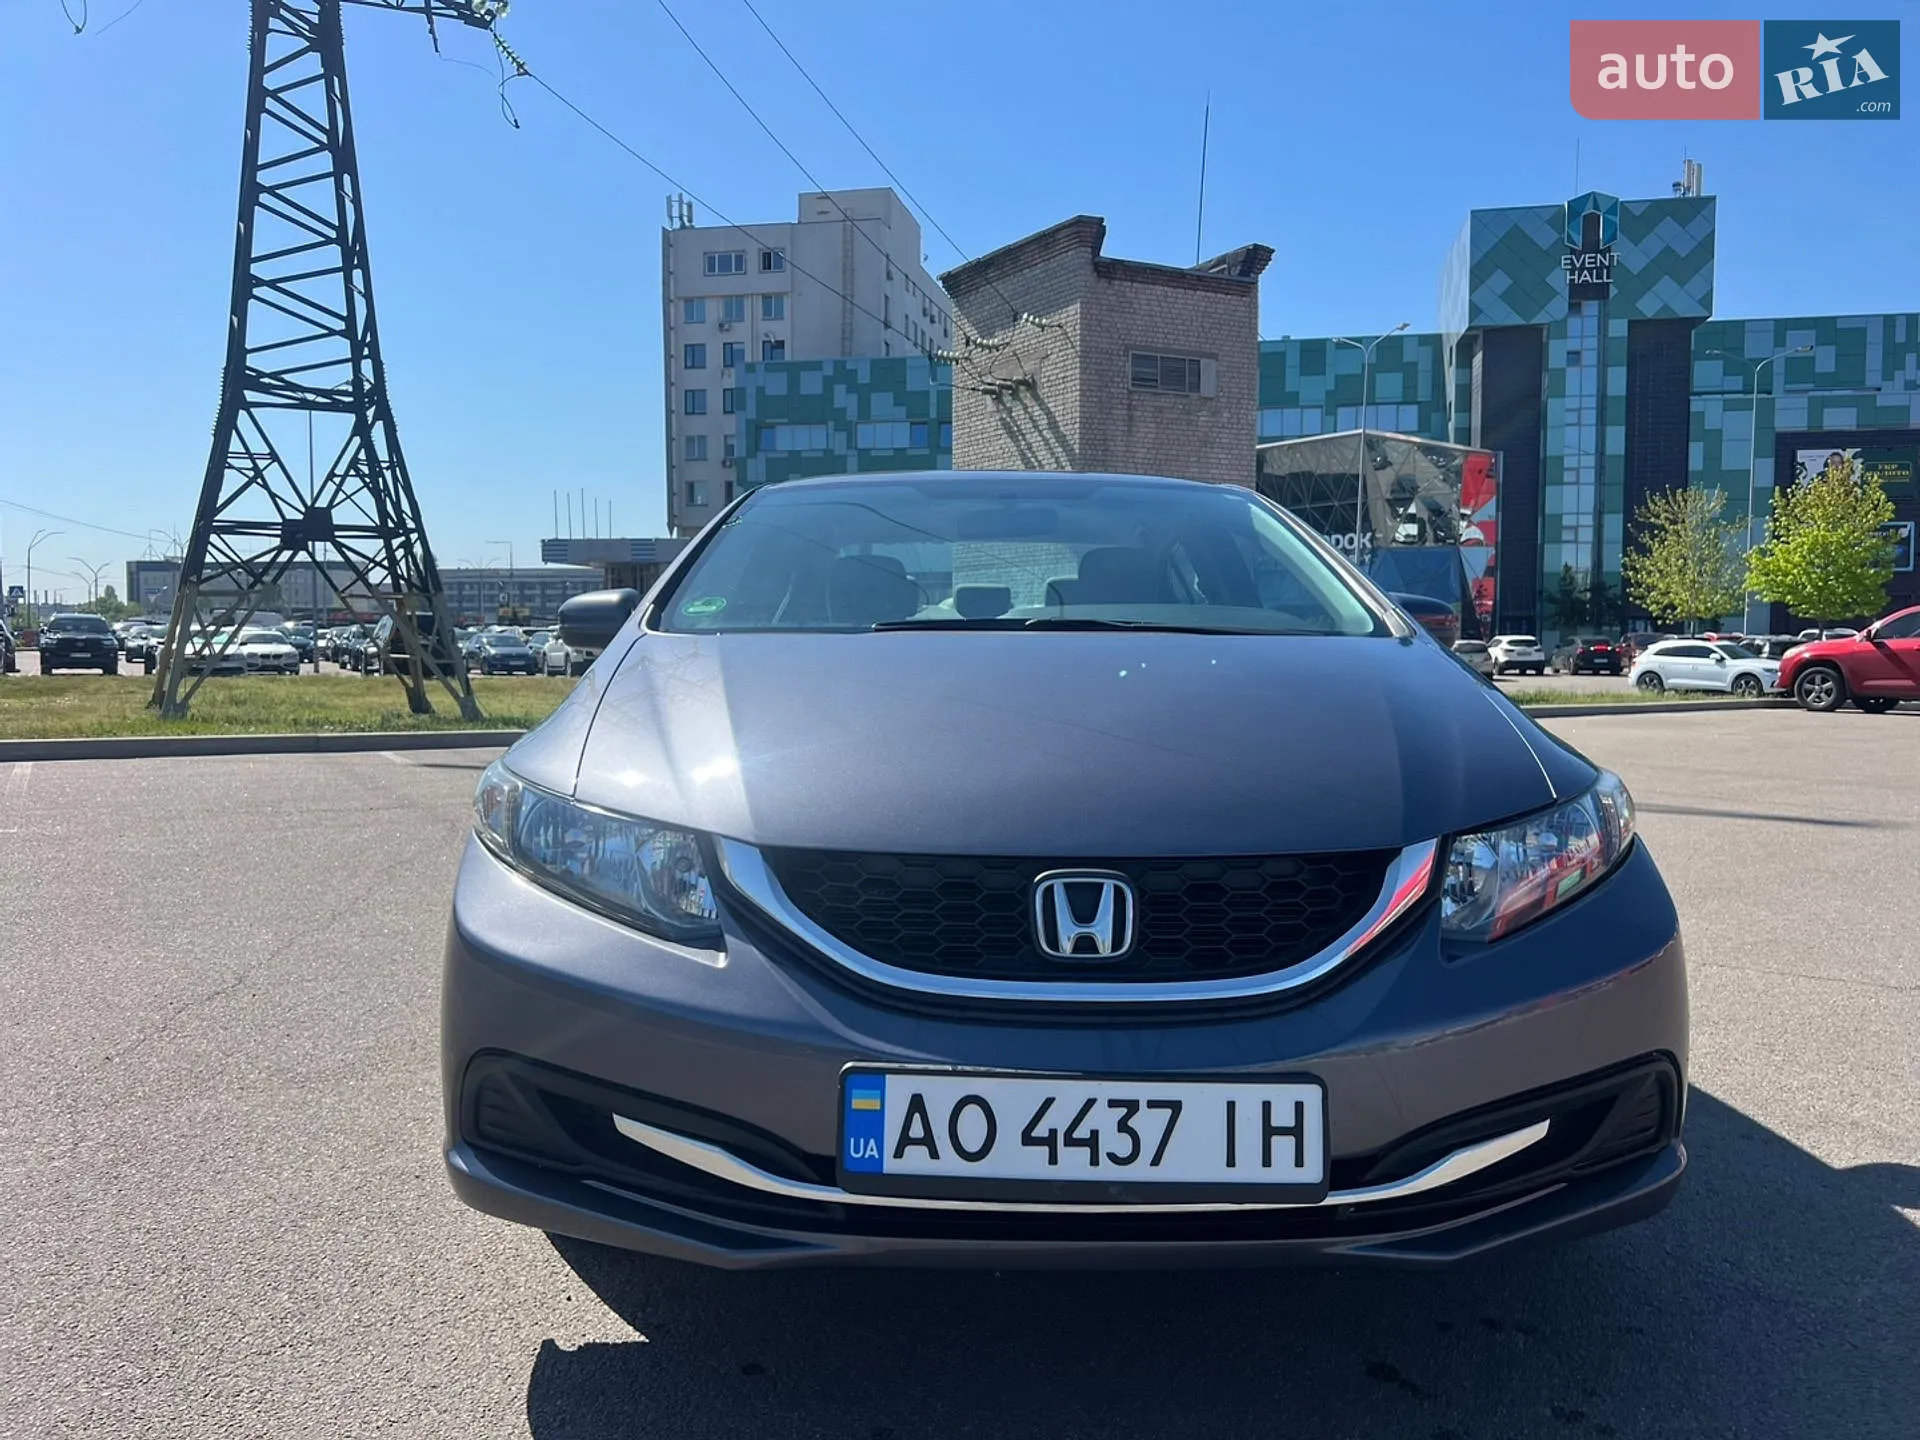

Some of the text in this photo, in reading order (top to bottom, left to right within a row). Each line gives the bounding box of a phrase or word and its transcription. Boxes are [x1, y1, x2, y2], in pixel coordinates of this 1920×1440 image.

[1561, 252, 1621, 269] EVENT
[1566, 268, 1613, 285] HALL
[893, 1093, 1304, 1168] AO 4437 IH
[850, 1137, 879, 1159] UA
